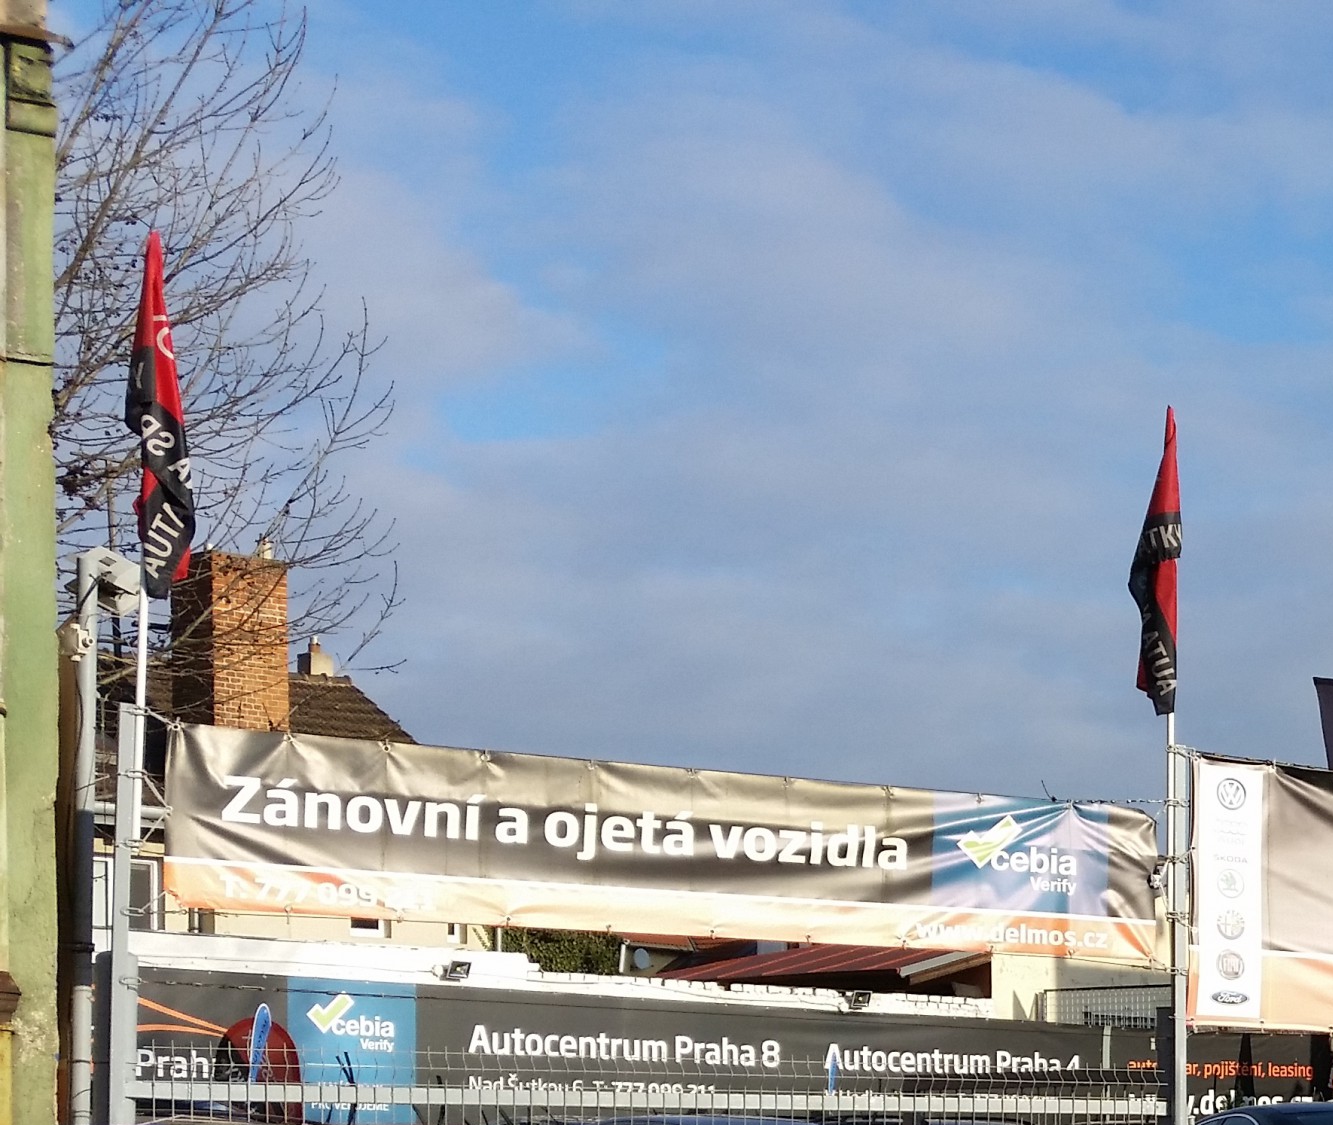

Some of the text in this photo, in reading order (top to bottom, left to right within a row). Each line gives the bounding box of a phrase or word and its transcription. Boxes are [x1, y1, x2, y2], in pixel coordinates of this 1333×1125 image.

[221, 775, 909, 871] Zánovní a ojetá vozidla
[991, 847, 1077, 876] cebia
[1030, 875, 1077, 896] Verify
[331, 1015, 394, 1038] cebia
[360, 1038, 394, 1053] Verify
[468, 1024, 781, 1068] Autocentrum Praha 8
[824, 1043, 989, 1074] Autocentrum
[995, 1050, 1060, 1073] Praha
[136, 1049, 217, 1079] Prah
[1203, 1059, 1266, 1080] pojištění,
[1268, 1061, 1314, 1081] leasing
